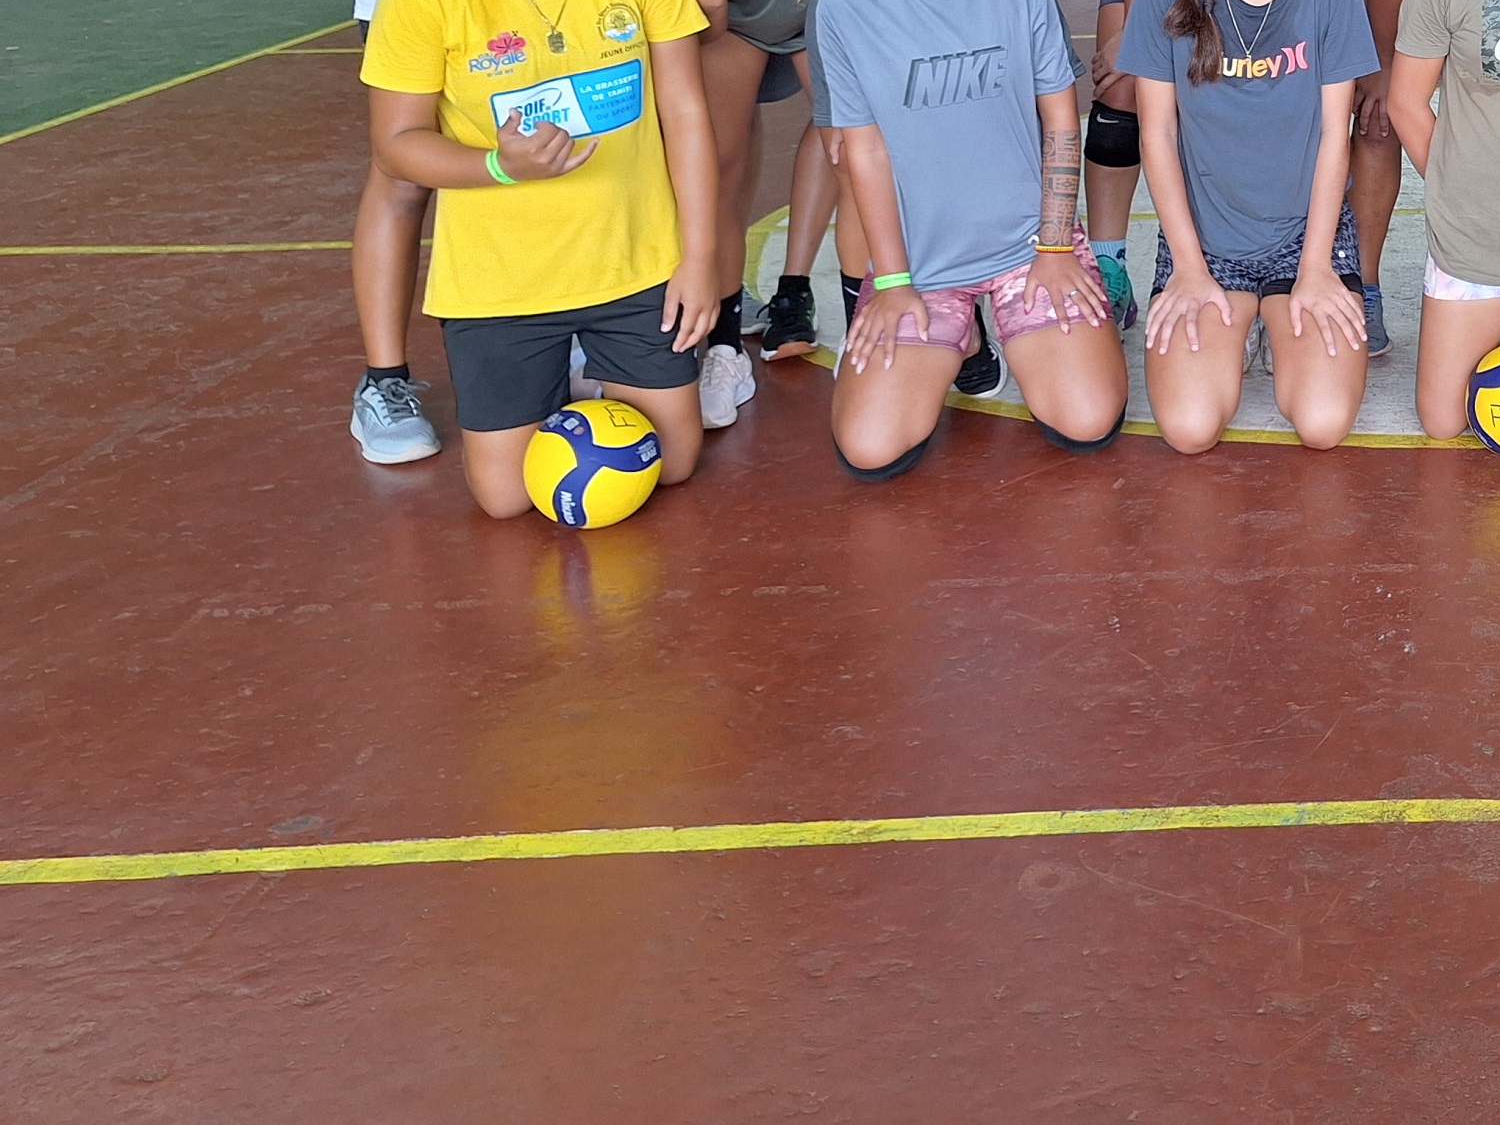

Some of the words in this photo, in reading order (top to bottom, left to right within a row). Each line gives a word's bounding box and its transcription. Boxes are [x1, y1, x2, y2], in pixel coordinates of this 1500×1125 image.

[468, 50, 527, 73] Royale
[600, 47, 624, 60] JEUNE
[1219, 52, 1283, 79] urley
[903, 45, 1008, 111] NIKE
